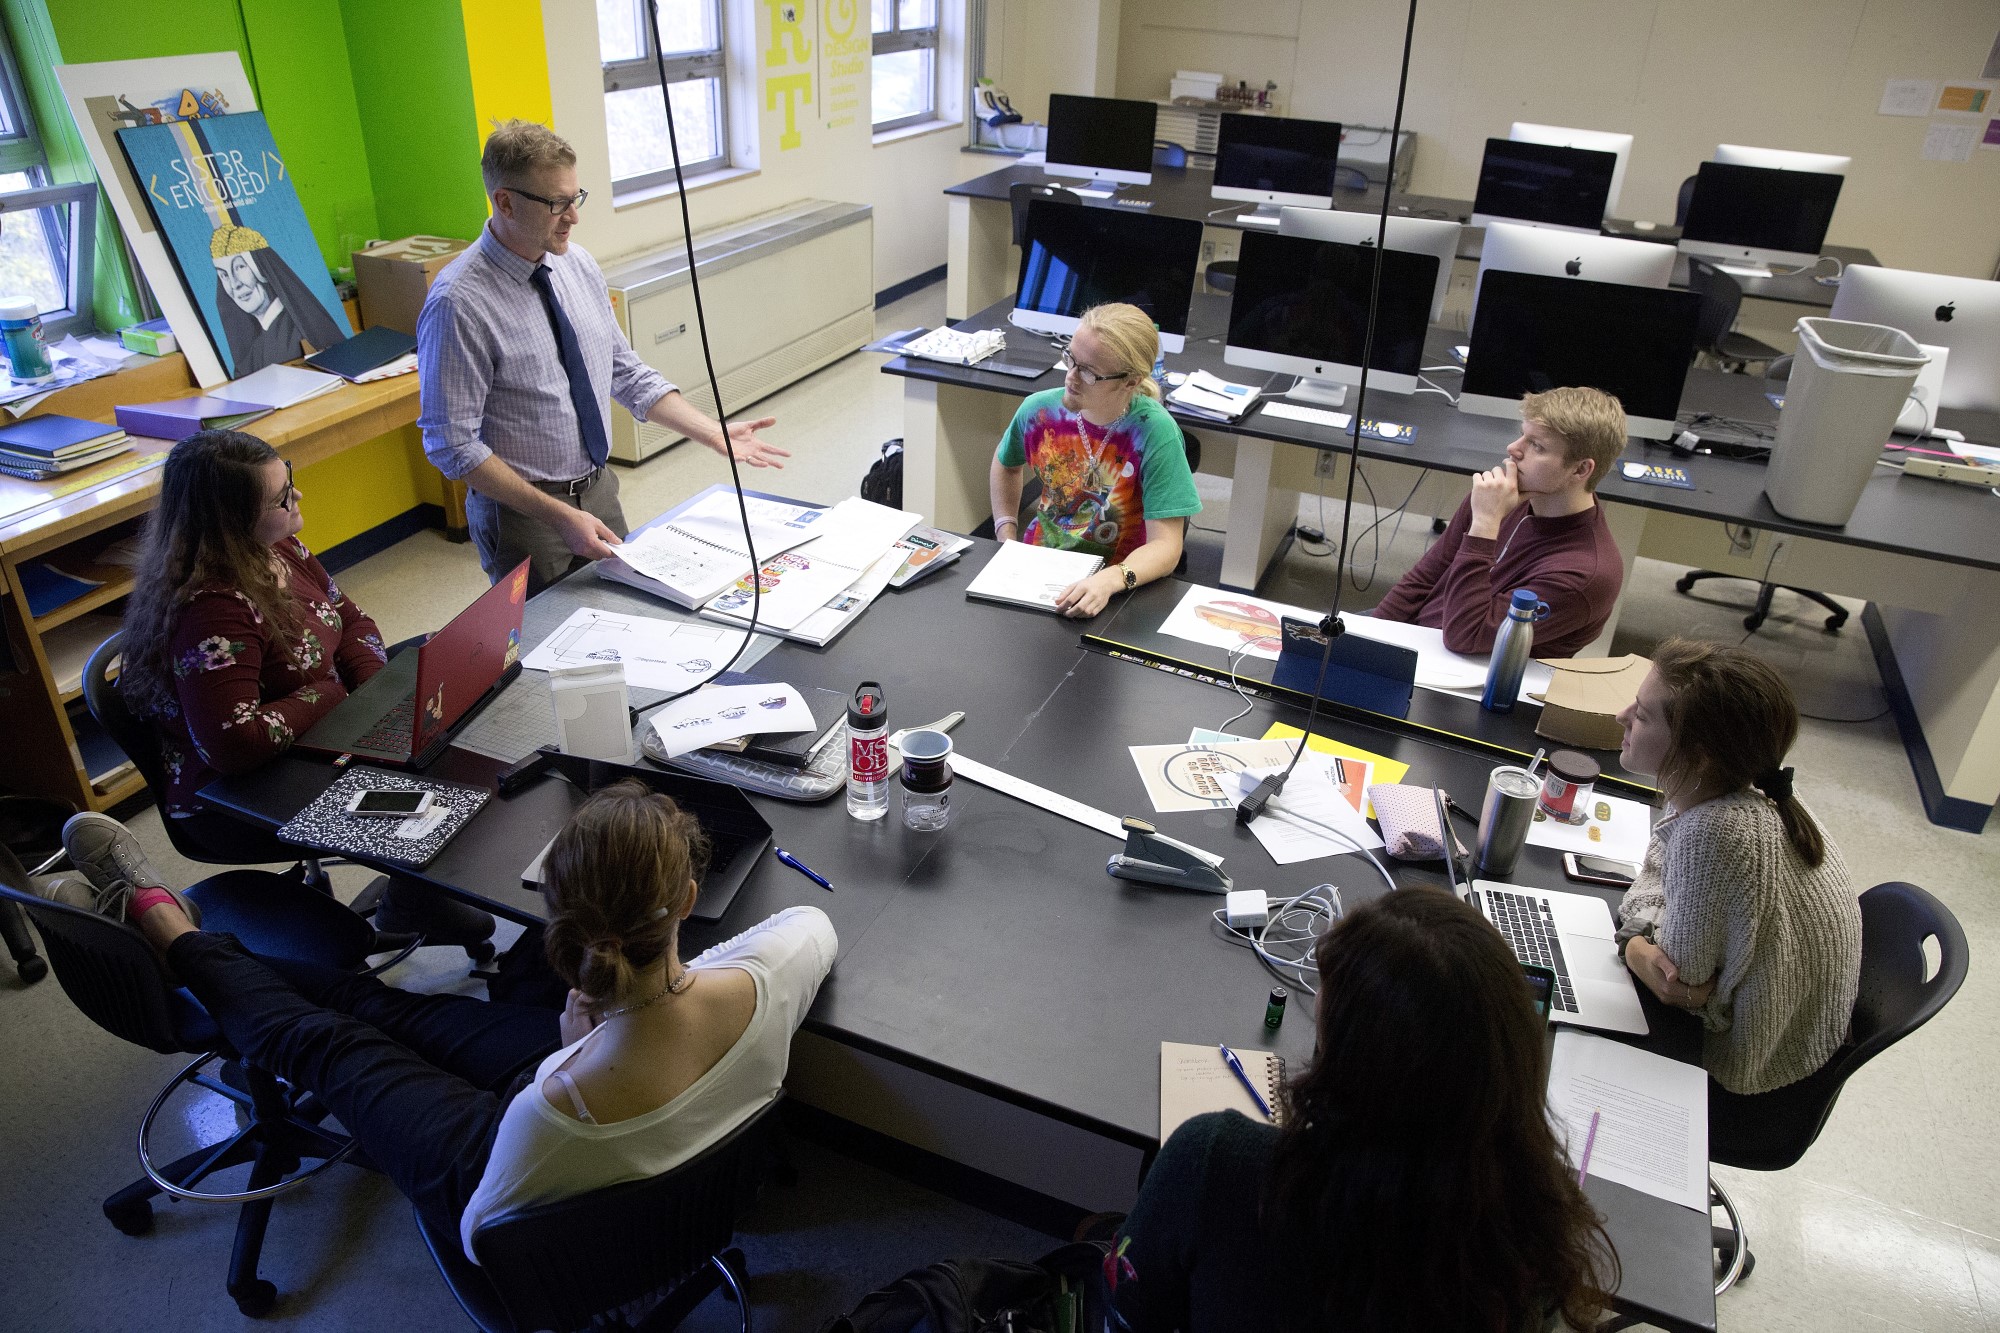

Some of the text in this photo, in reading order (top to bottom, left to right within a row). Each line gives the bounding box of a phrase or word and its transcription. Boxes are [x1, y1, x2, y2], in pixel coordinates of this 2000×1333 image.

[170, 149, 249, 186] SIST3R
[855, 736, 887, 757] MS
[854, 771, 887, 782] UNIVERSITY
